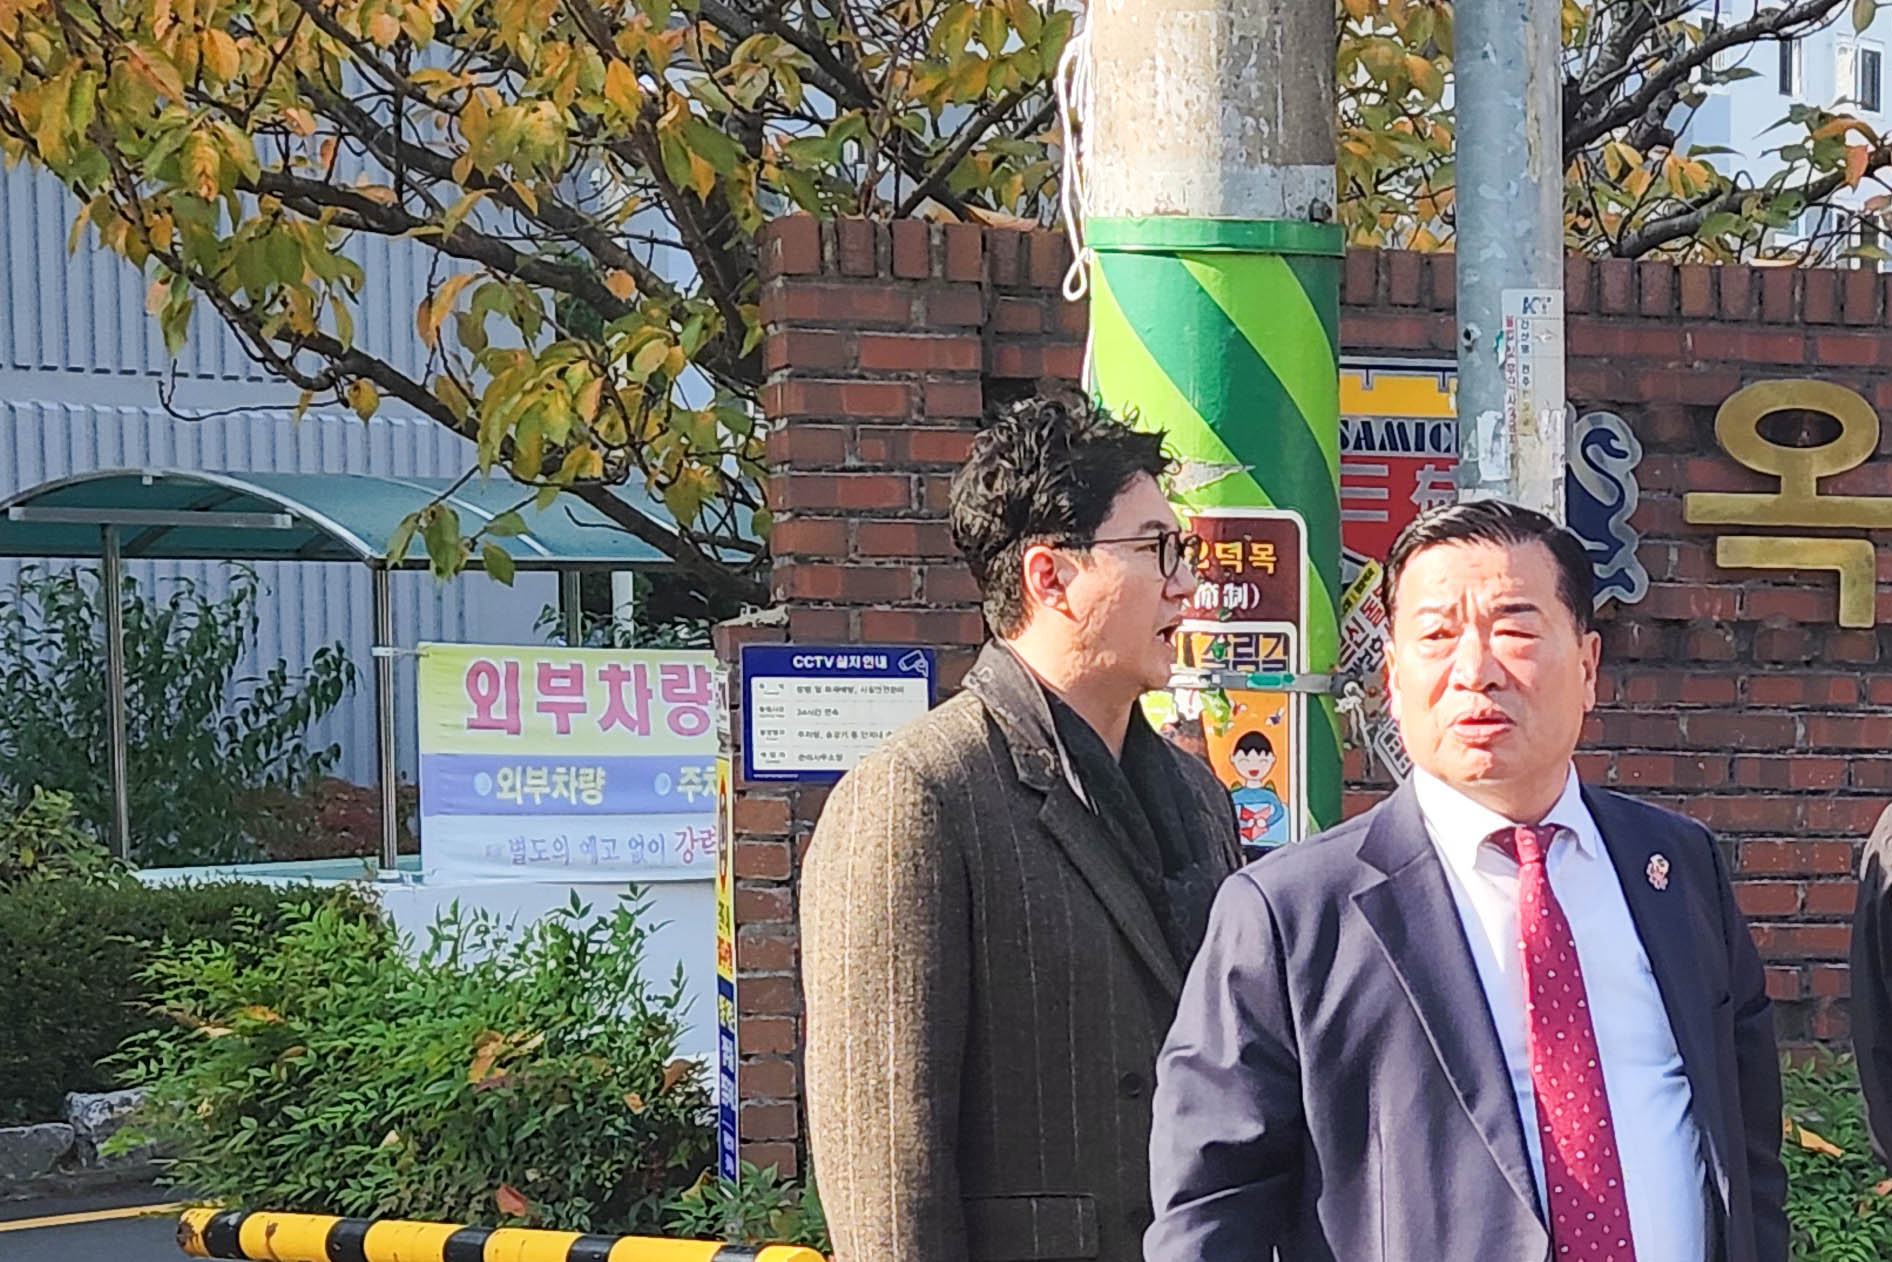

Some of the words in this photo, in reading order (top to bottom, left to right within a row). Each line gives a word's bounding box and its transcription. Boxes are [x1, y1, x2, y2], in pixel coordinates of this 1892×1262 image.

[1340, 420, 1460, 453] SAMIC
[793, 655, 835, 669] CCTV
[466, 659, 713, 737] 외부차량
[496, 765, 606, 805] 외부차량
[509, 835, 569, 866] 별도의
[628, 833, 665, 865] 없이
